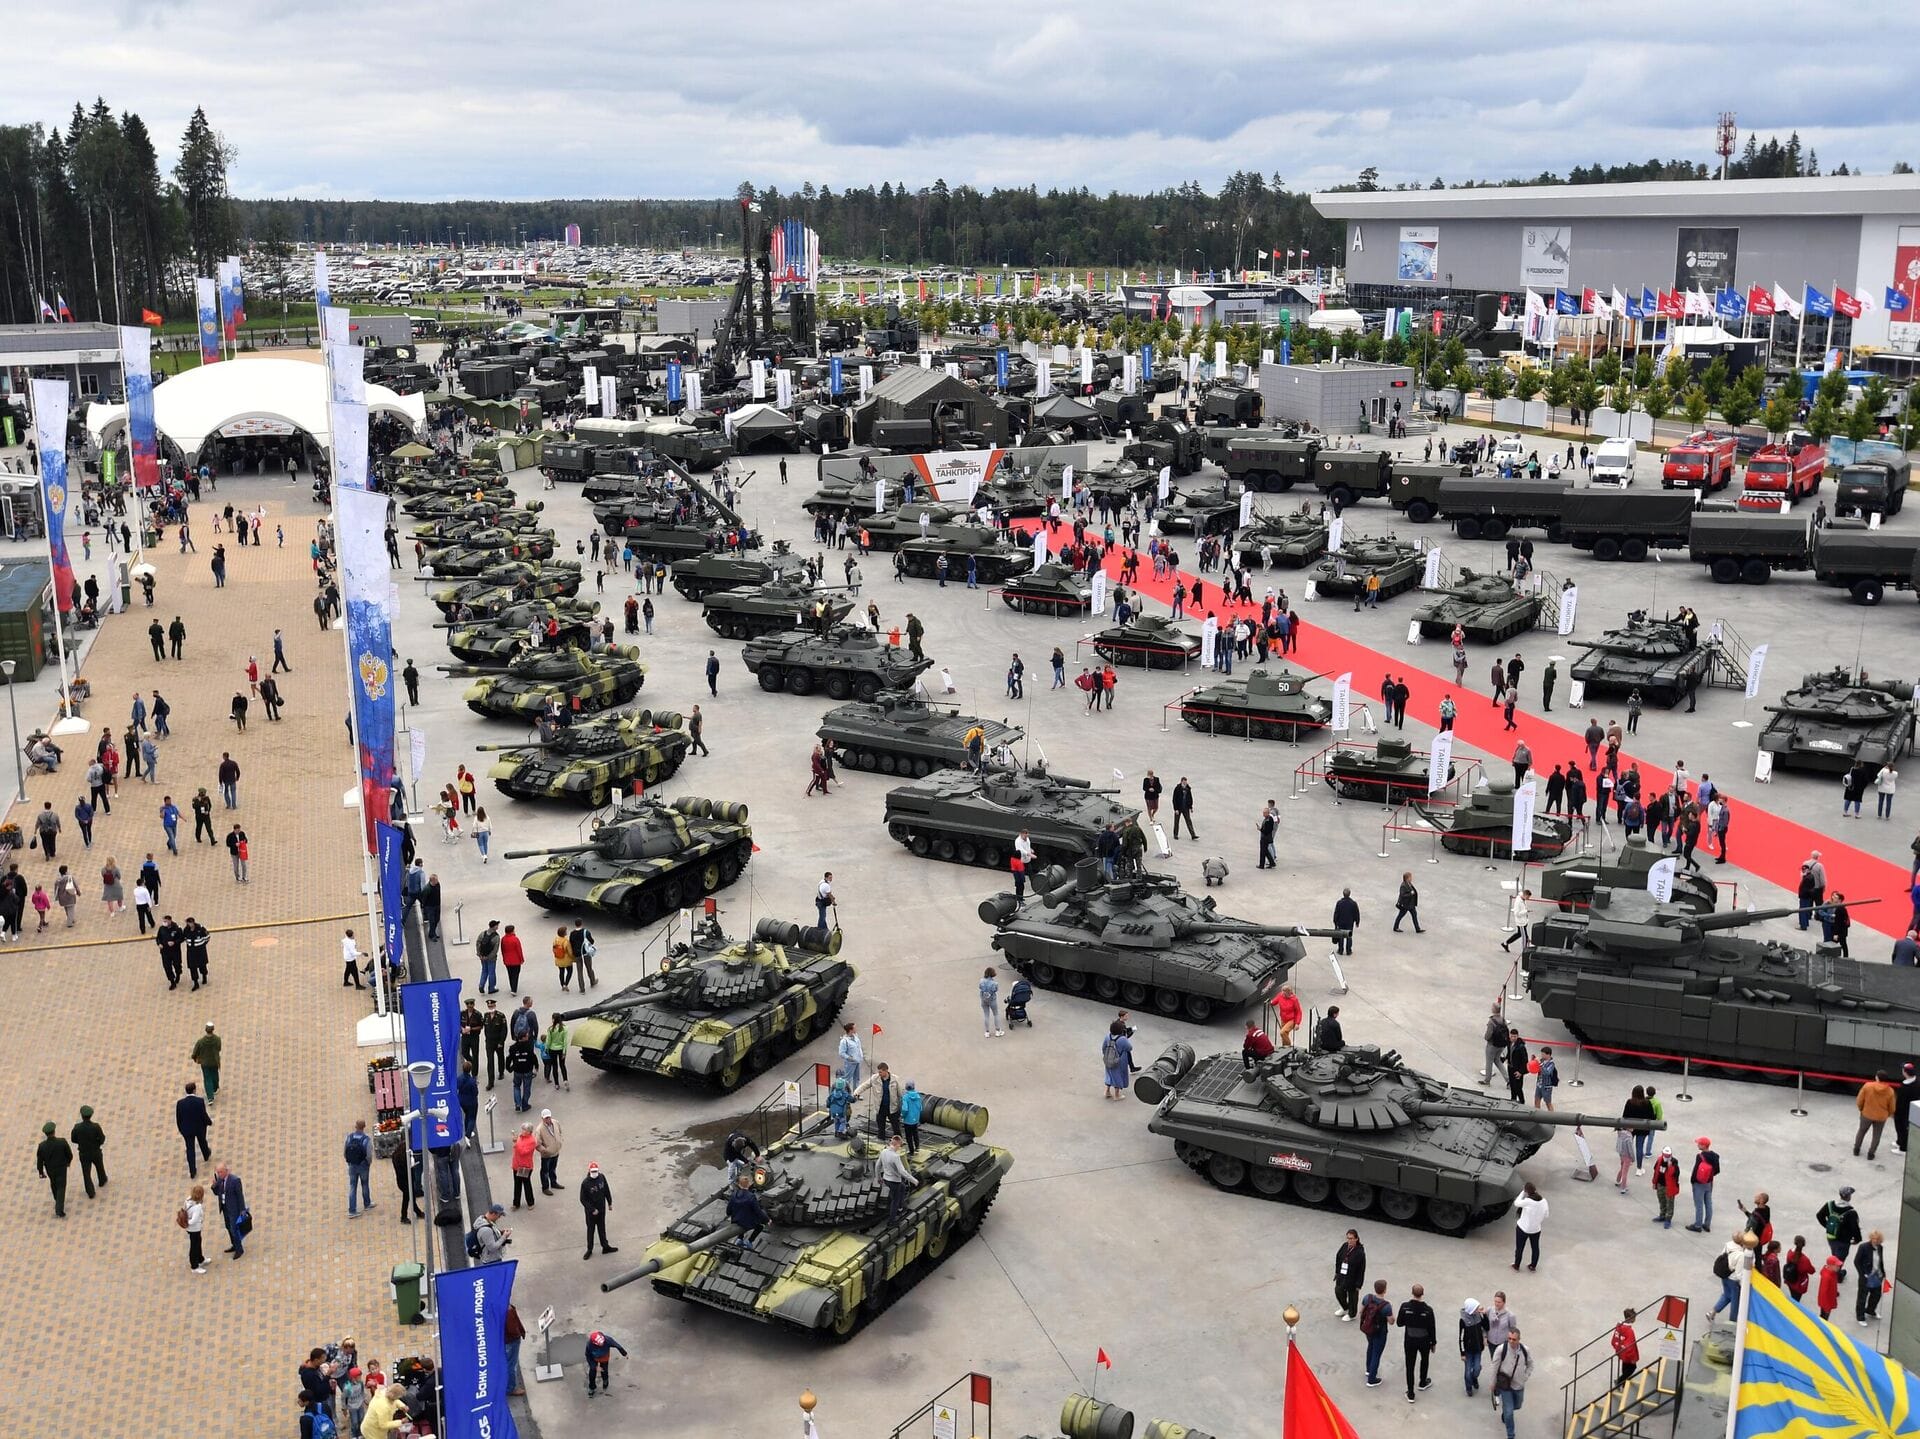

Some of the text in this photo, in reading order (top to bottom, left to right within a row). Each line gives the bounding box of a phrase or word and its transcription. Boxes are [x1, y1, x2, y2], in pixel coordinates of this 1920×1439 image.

[1352, 226, 1363, 251] А
[1697, 251, 1728, 260] ВЕРТОЛЕТЫ
[1697, 259, 1718, 268] РОССИИ
[936, 468, 981, 477] ТАНКПРОМ
[1564, 600, 1573, 632] ТАНКПРОМ
[1278, 683, 1290, 691] 50
[1656, 879, 1666, 902] ТАНК
[430, 992, 445, 1087] Банк сильных людей
[473, 1279, 485, 1316] людей
[474, 1318, 487, 1367] сильных
[476, 1369, 487, 1399] Банк
